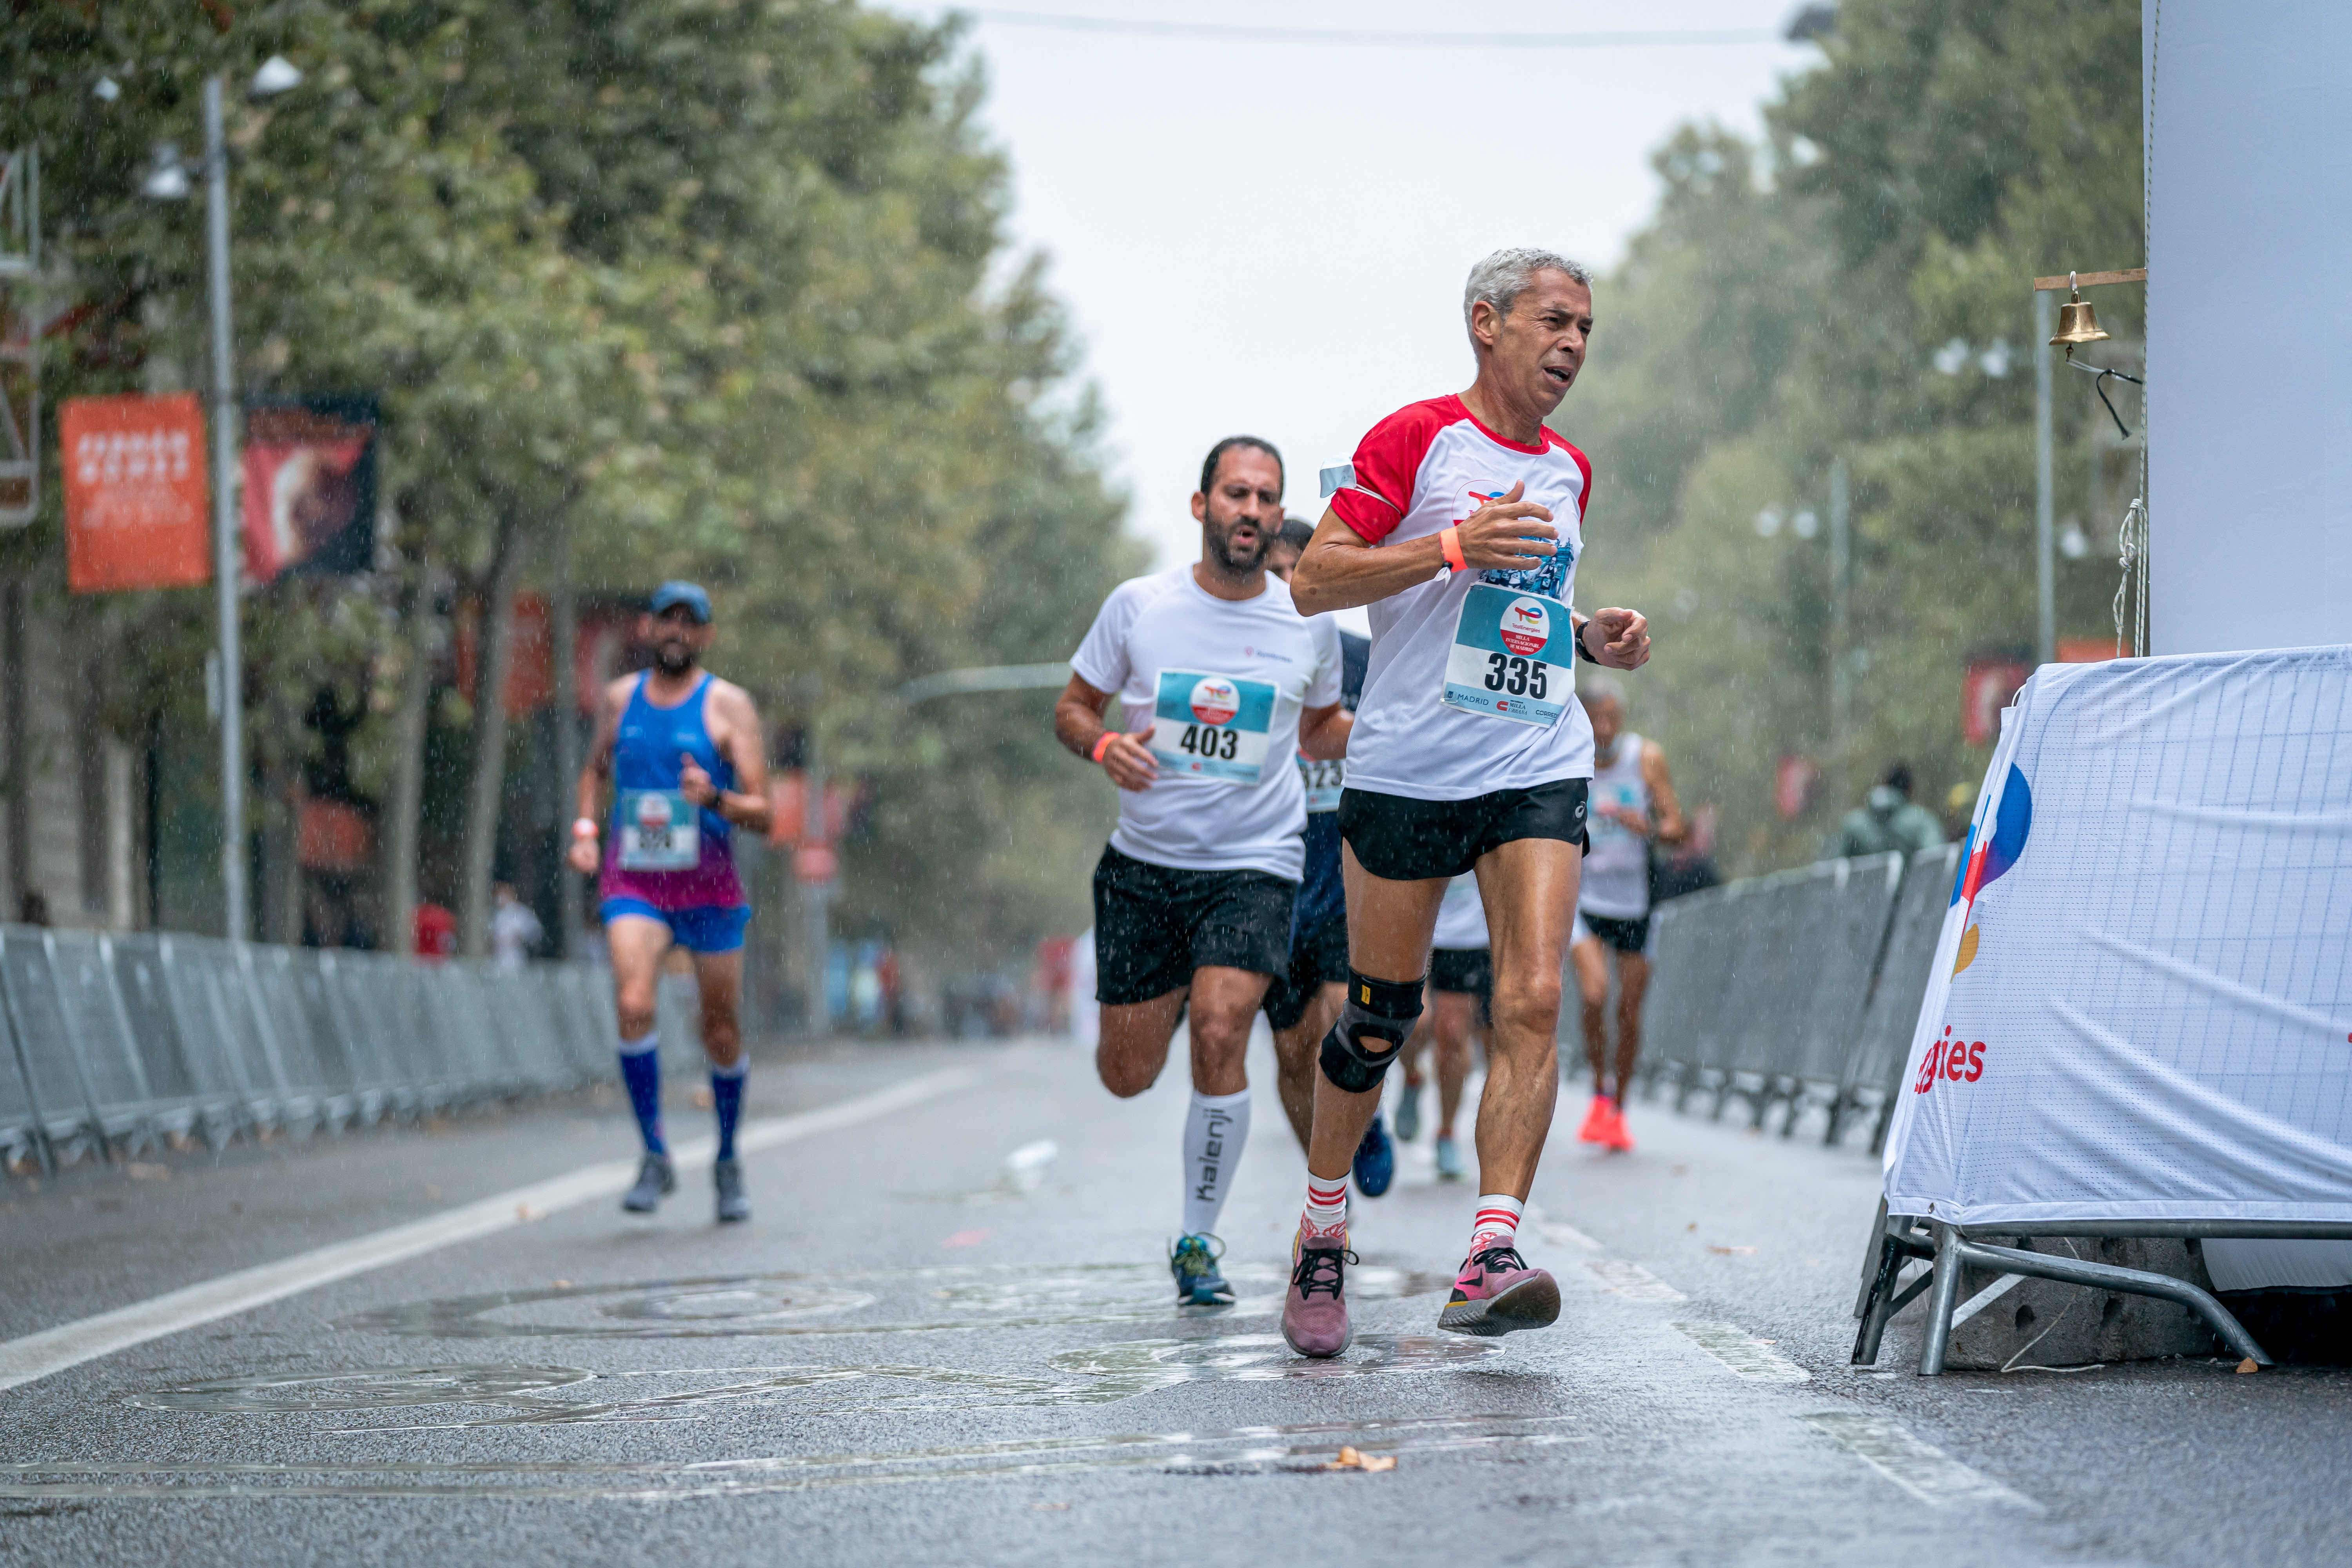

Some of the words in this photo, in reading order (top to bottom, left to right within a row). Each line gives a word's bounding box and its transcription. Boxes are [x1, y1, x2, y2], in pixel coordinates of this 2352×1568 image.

[1485, 653, 1547, 699] 335
[1458, 693, 1489, 706] MADRID
[1180, 724, 1239, 760] 403
[1195, 1108, 1233, 1202] Kalenji
